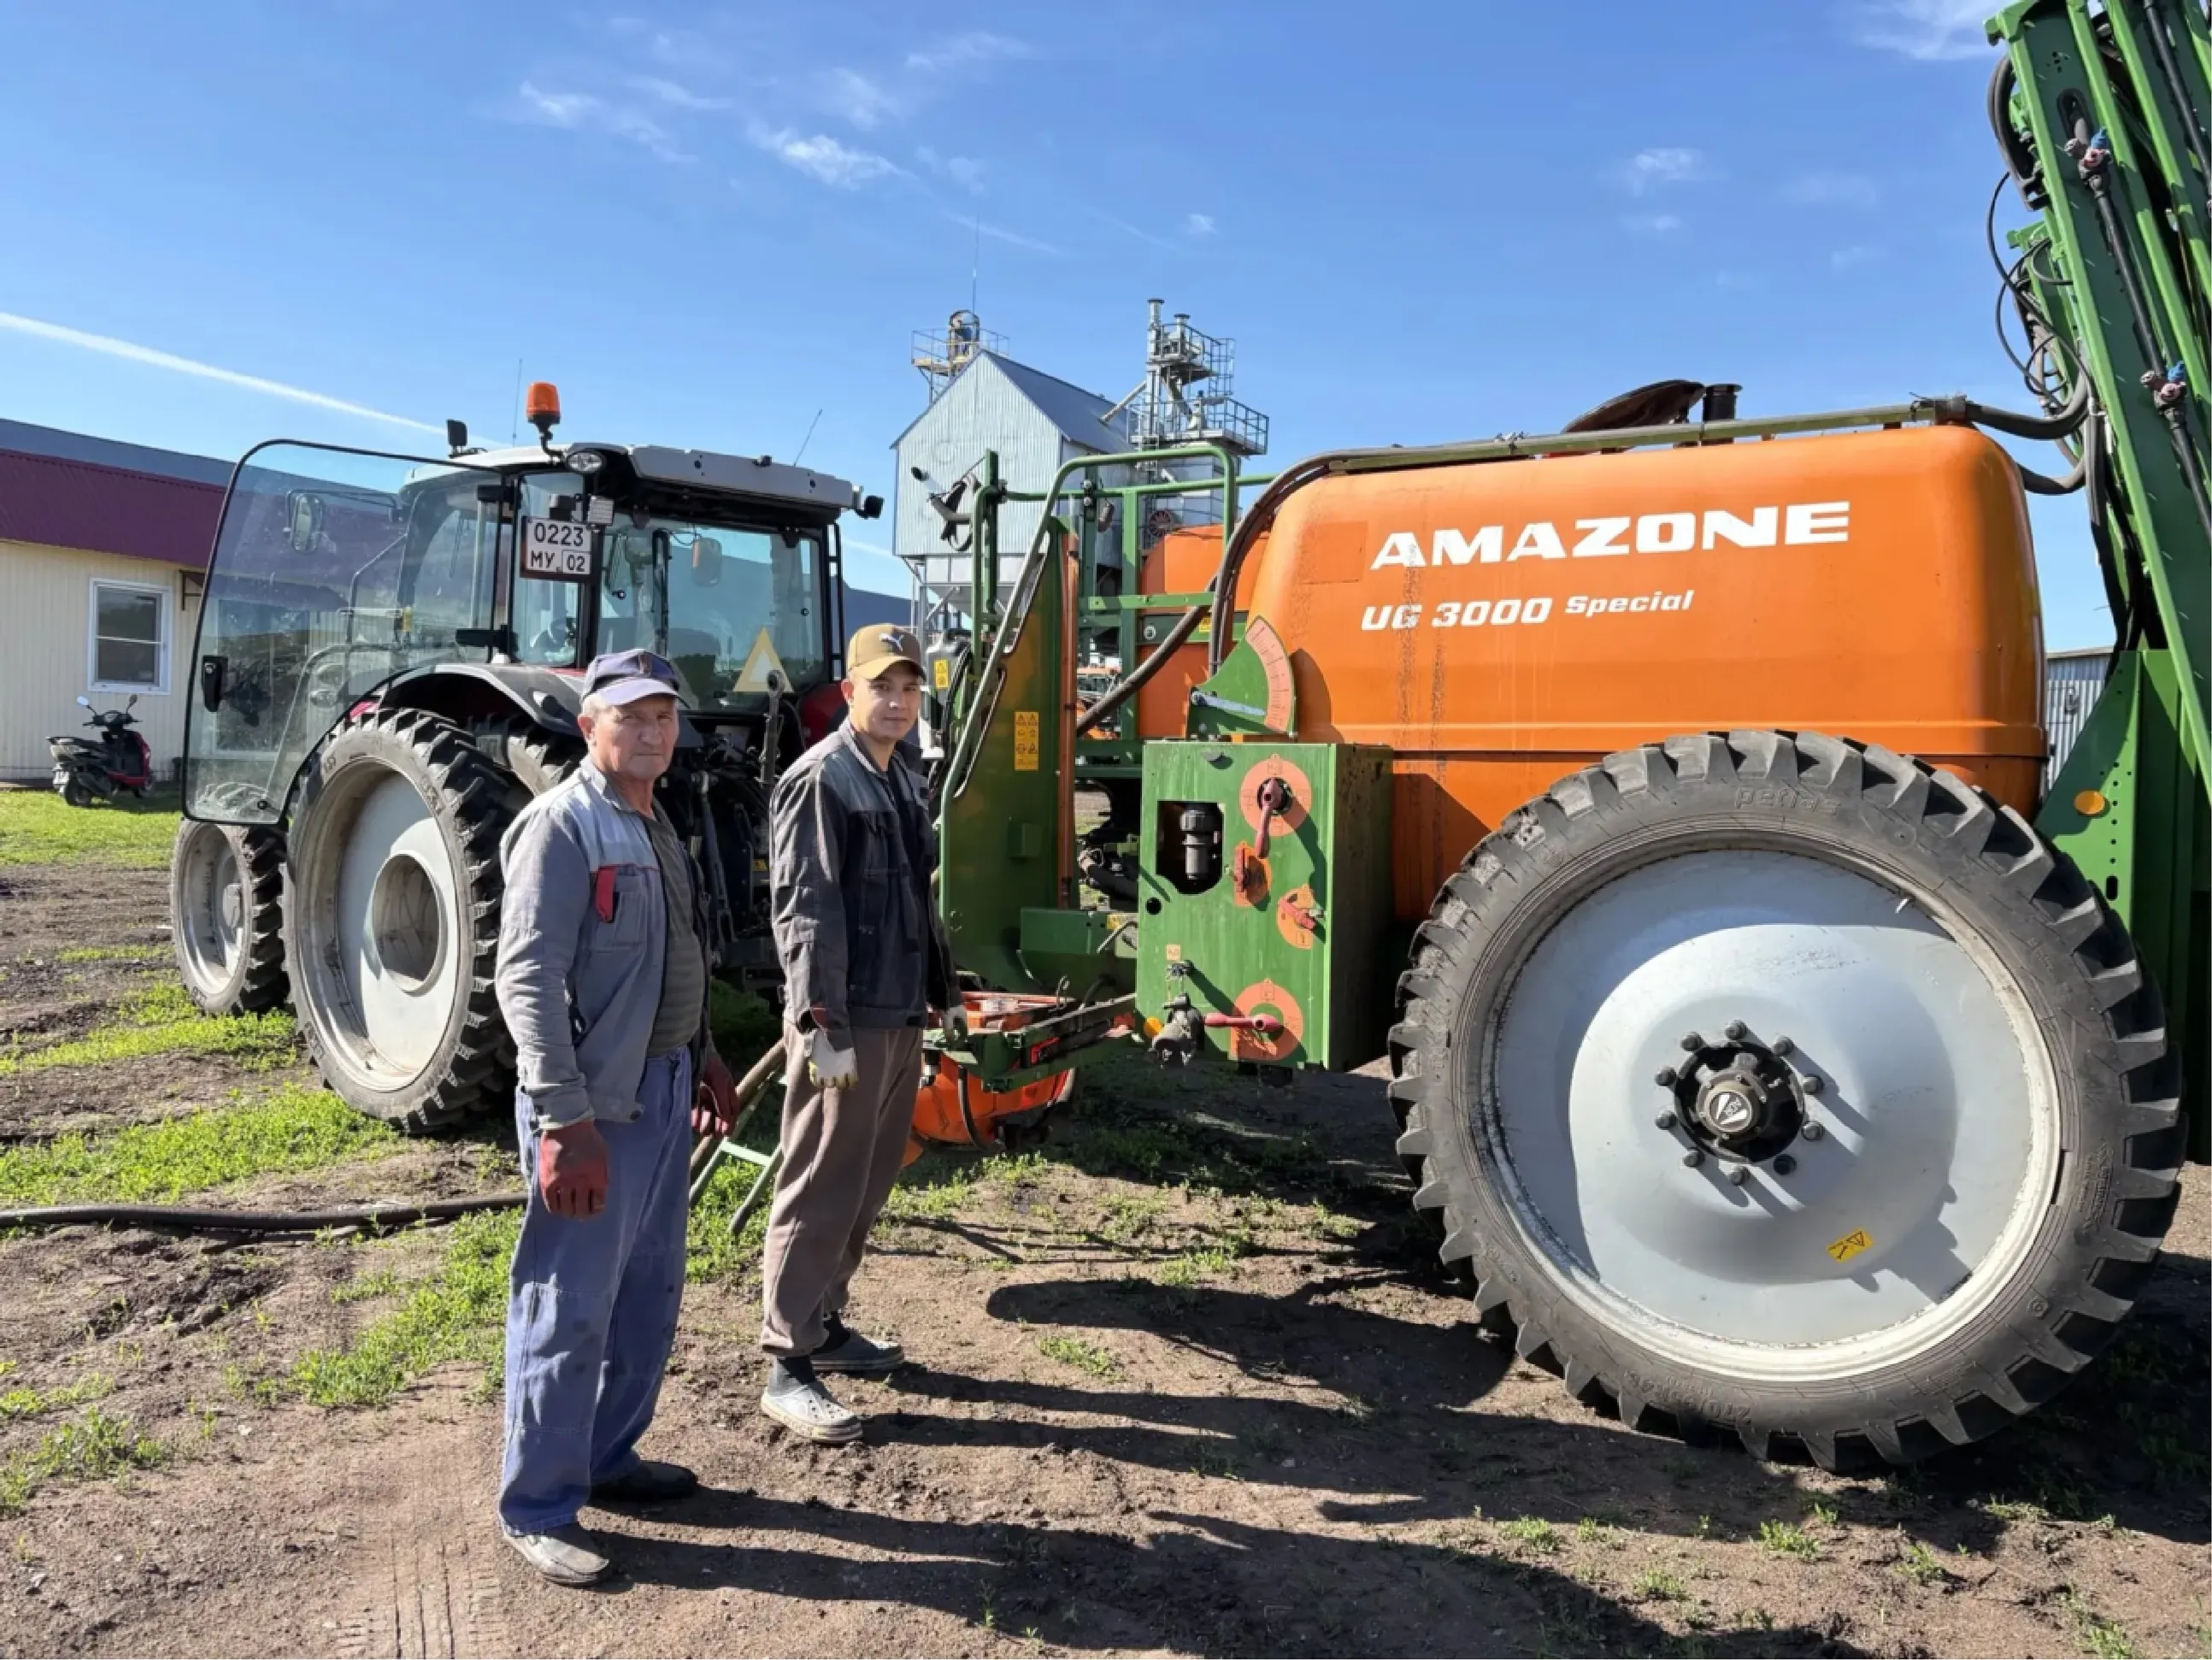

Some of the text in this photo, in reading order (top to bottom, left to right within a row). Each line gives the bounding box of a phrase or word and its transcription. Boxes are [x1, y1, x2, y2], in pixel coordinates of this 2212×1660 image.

[533, 522, 584, 547] 0223
[1370, 500, 1850, 569] AMAZONE
[531, 550, 585, 573] МУ 02
[1361, 590, 1694, 631] UG 3000 Special
